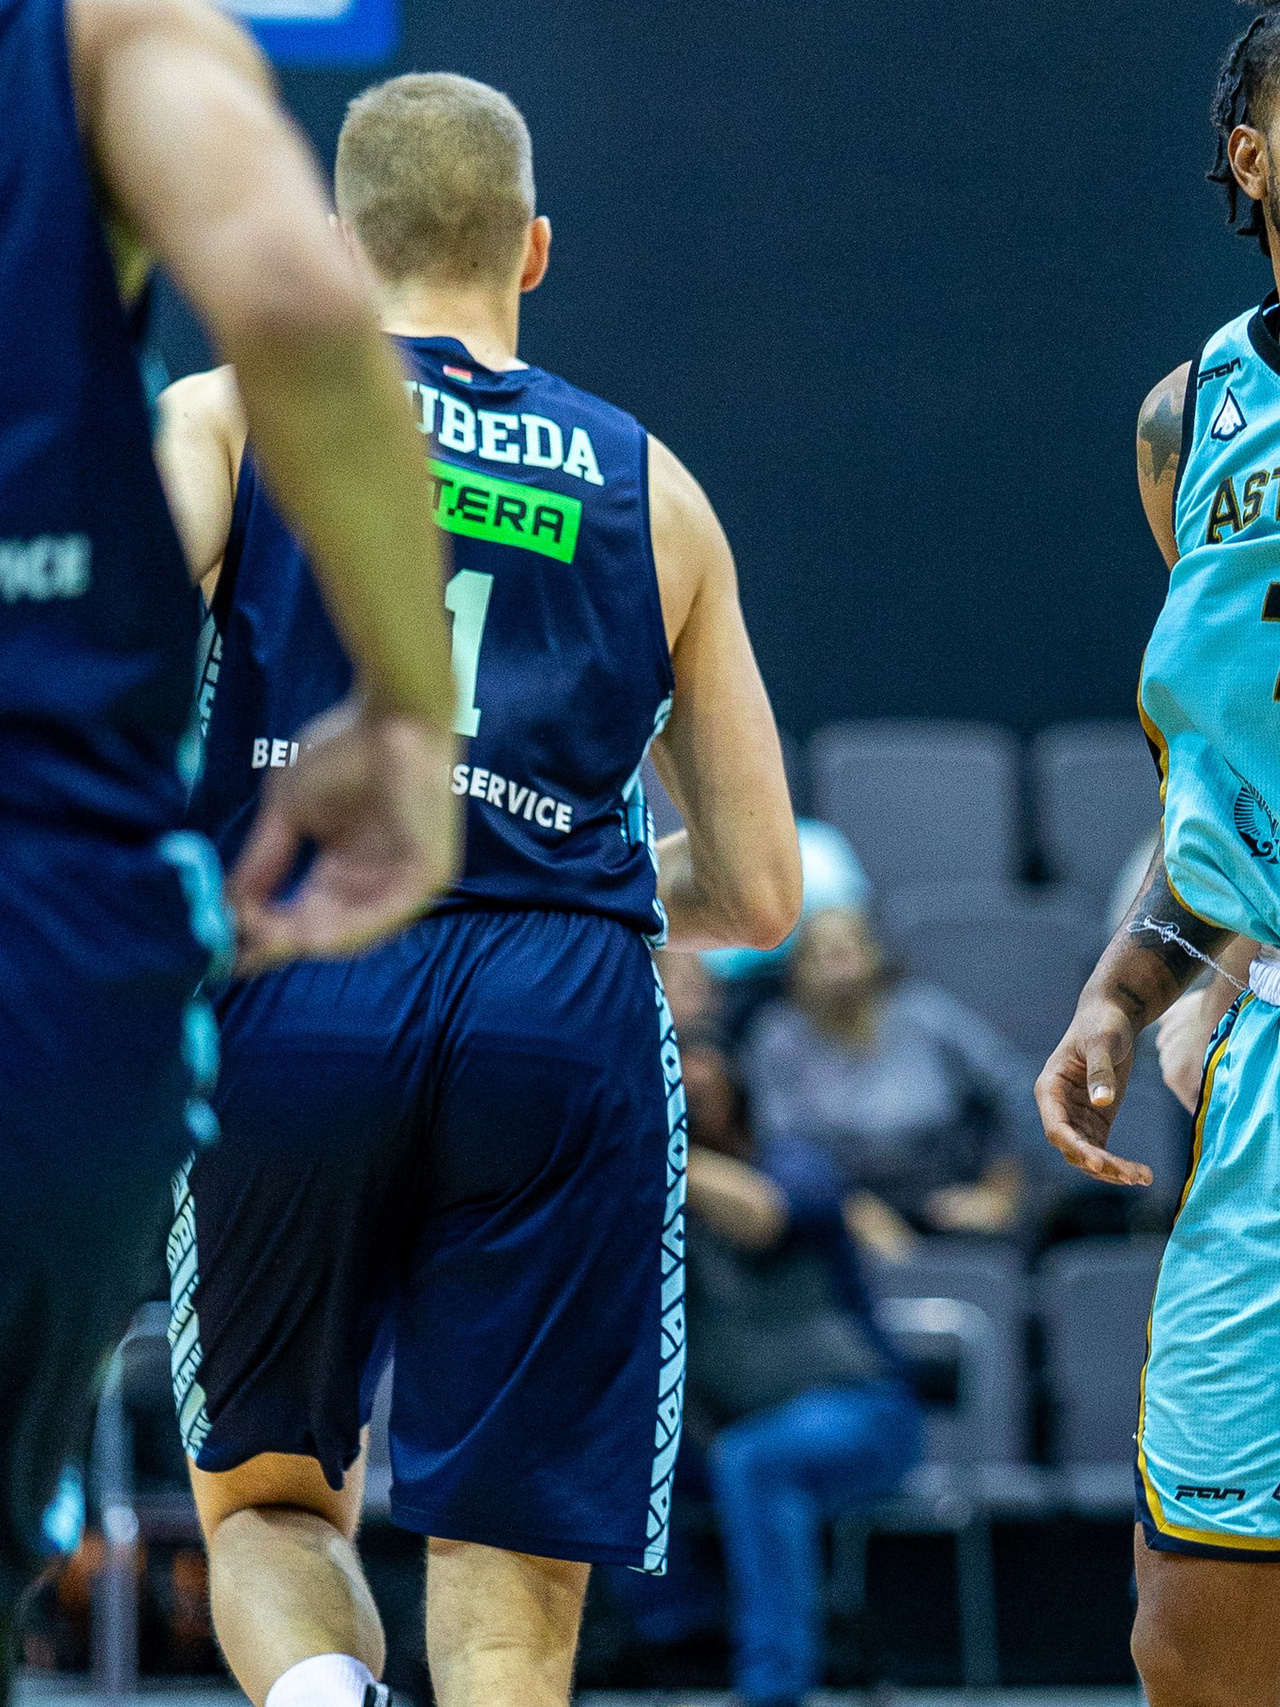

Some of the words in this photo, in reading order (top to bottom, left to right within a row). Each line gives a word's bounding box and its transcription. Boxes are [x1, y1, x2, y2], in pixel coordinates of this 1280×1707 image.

[404, 379, 605, 487] UBEDA
[431, 479, 564, 544] TERA
[450, 763, 574, 834] SERVICE
